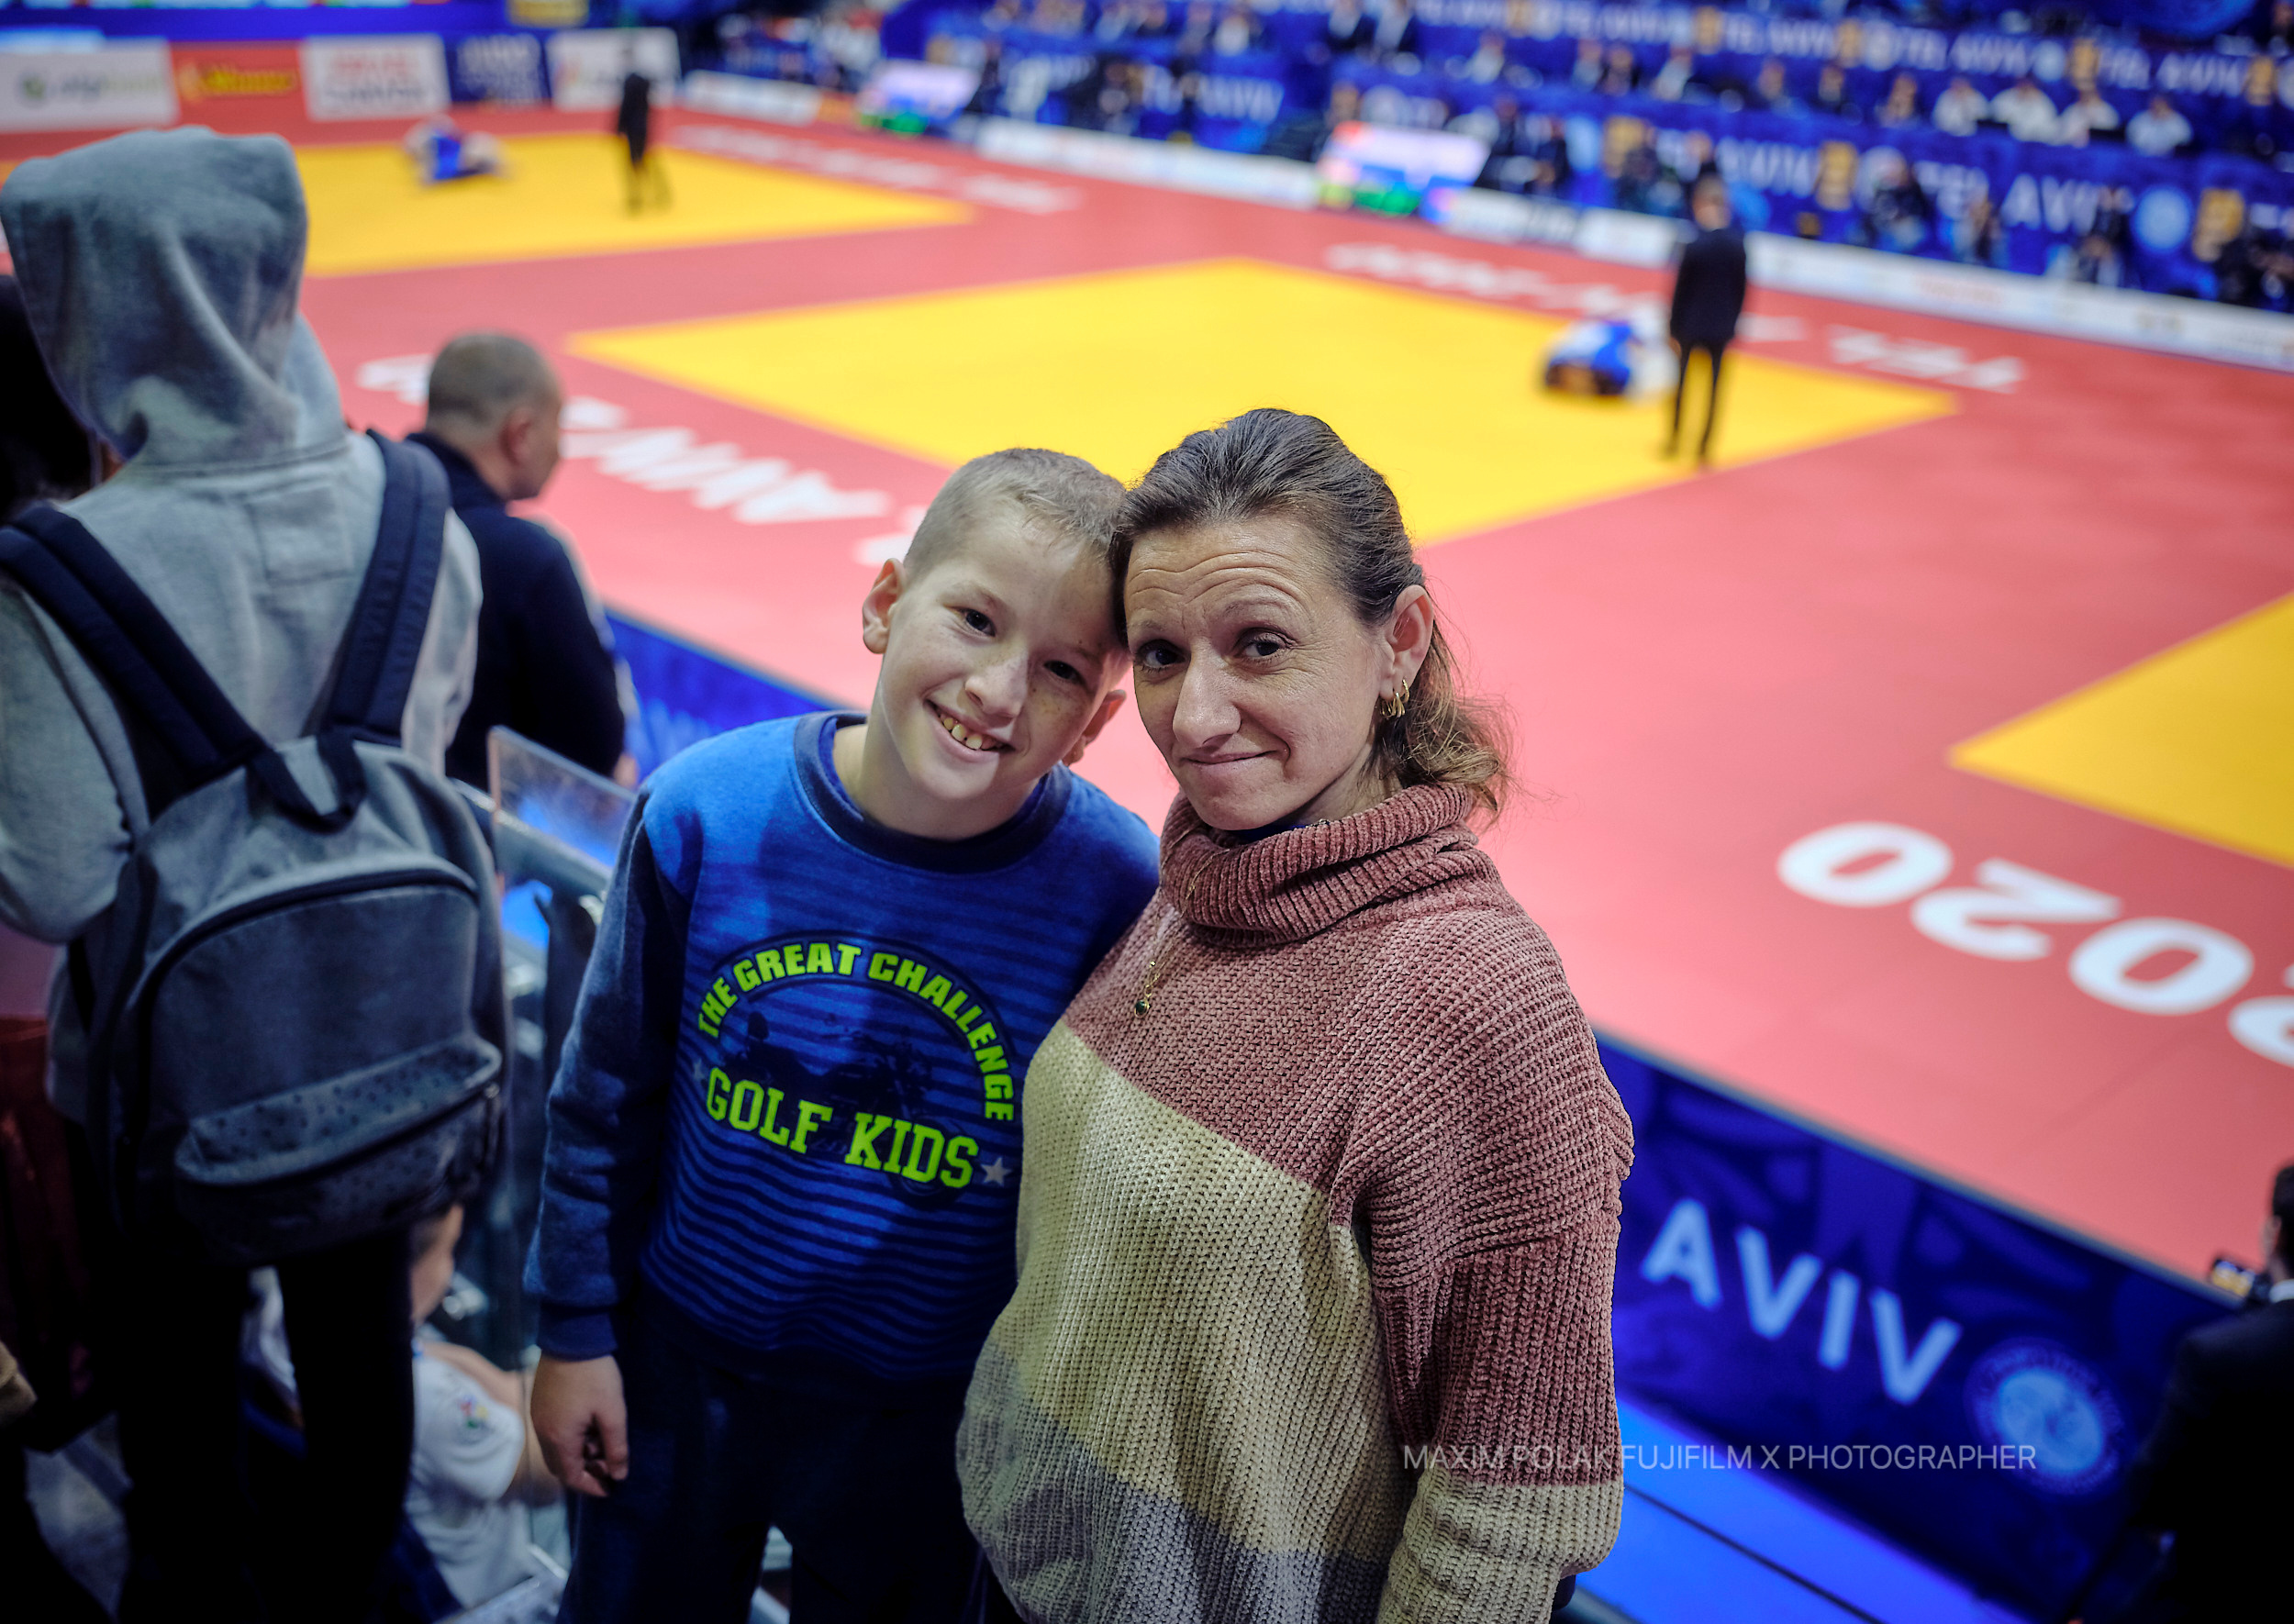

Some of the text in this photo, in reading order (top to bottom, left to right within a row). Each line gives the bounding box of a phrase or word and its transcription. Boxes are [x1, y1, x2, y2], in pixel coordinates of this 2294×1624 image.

[698, 942, 1014, 1121] THE GREAT CHALLENGE
[707, 1067, 979, 1187] GOLF KIDS
[1641, 1197, 1962, 1405] AVIV
